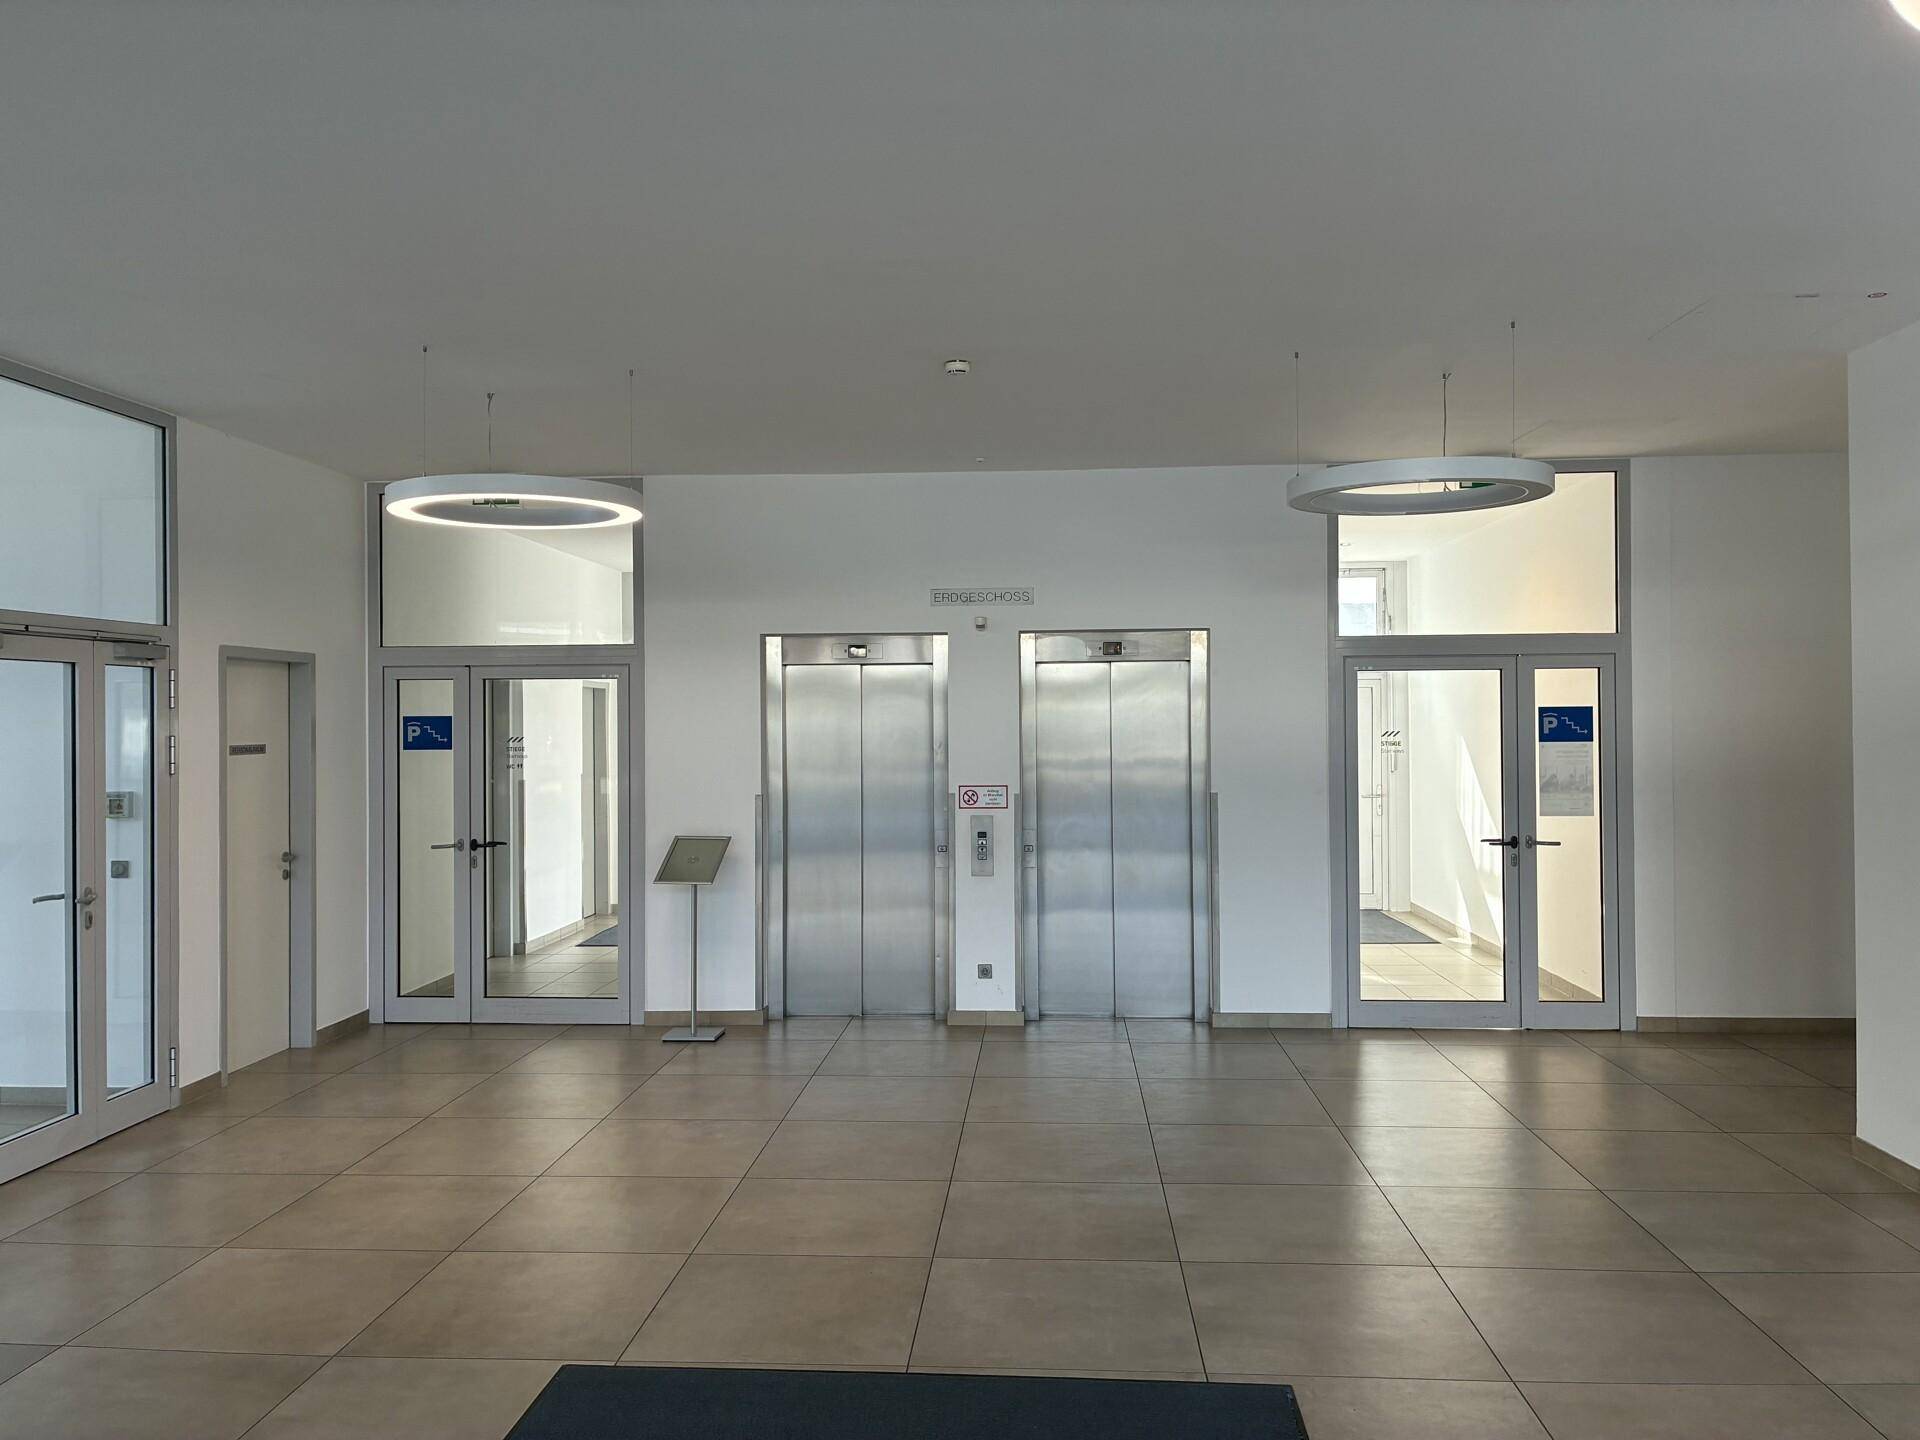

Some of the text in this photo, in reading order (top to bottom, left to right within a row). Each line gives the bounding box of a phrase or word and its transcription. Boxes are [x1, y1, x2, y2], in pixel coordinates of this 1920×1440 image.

[933, 591, 1030, 603] ERDGESCHOSS
[407, 725, 421, 742] P
[1543, 716, 1558, 734] P
